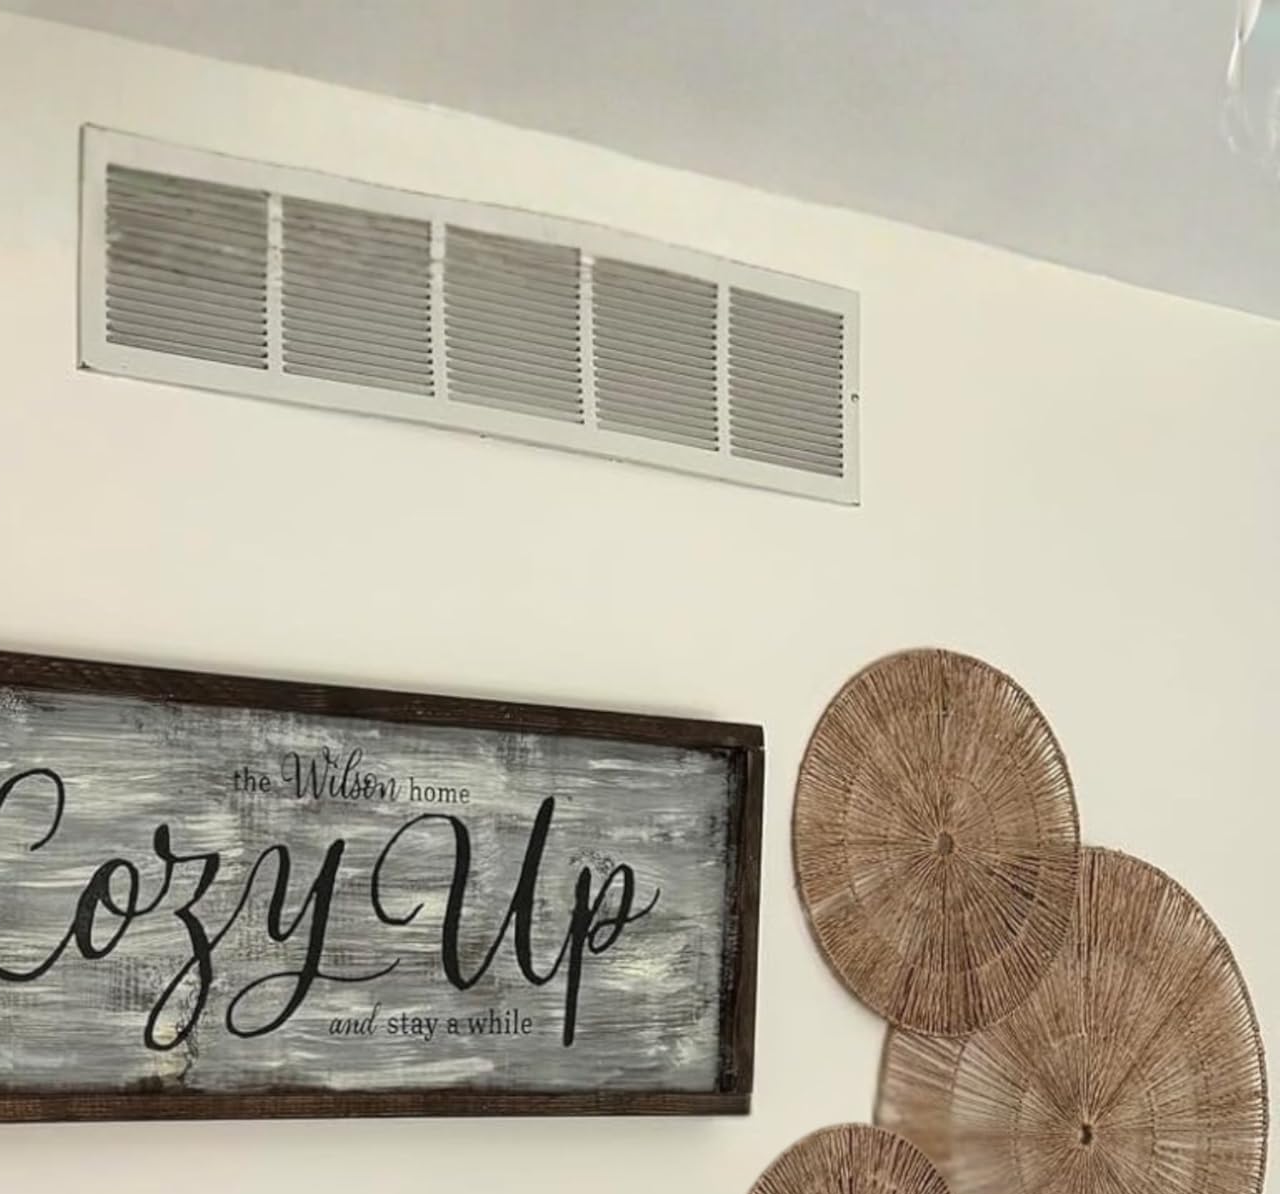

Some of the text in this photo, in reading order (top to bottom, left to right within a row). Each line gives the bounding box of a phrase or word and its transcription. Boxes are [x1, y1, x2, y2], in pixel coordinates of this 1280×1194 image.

[233, 745, 471, 804] the Wilson home
[371, 795, 662, 1047] Up
[328, 1001, 533, 1042] and stay a while
